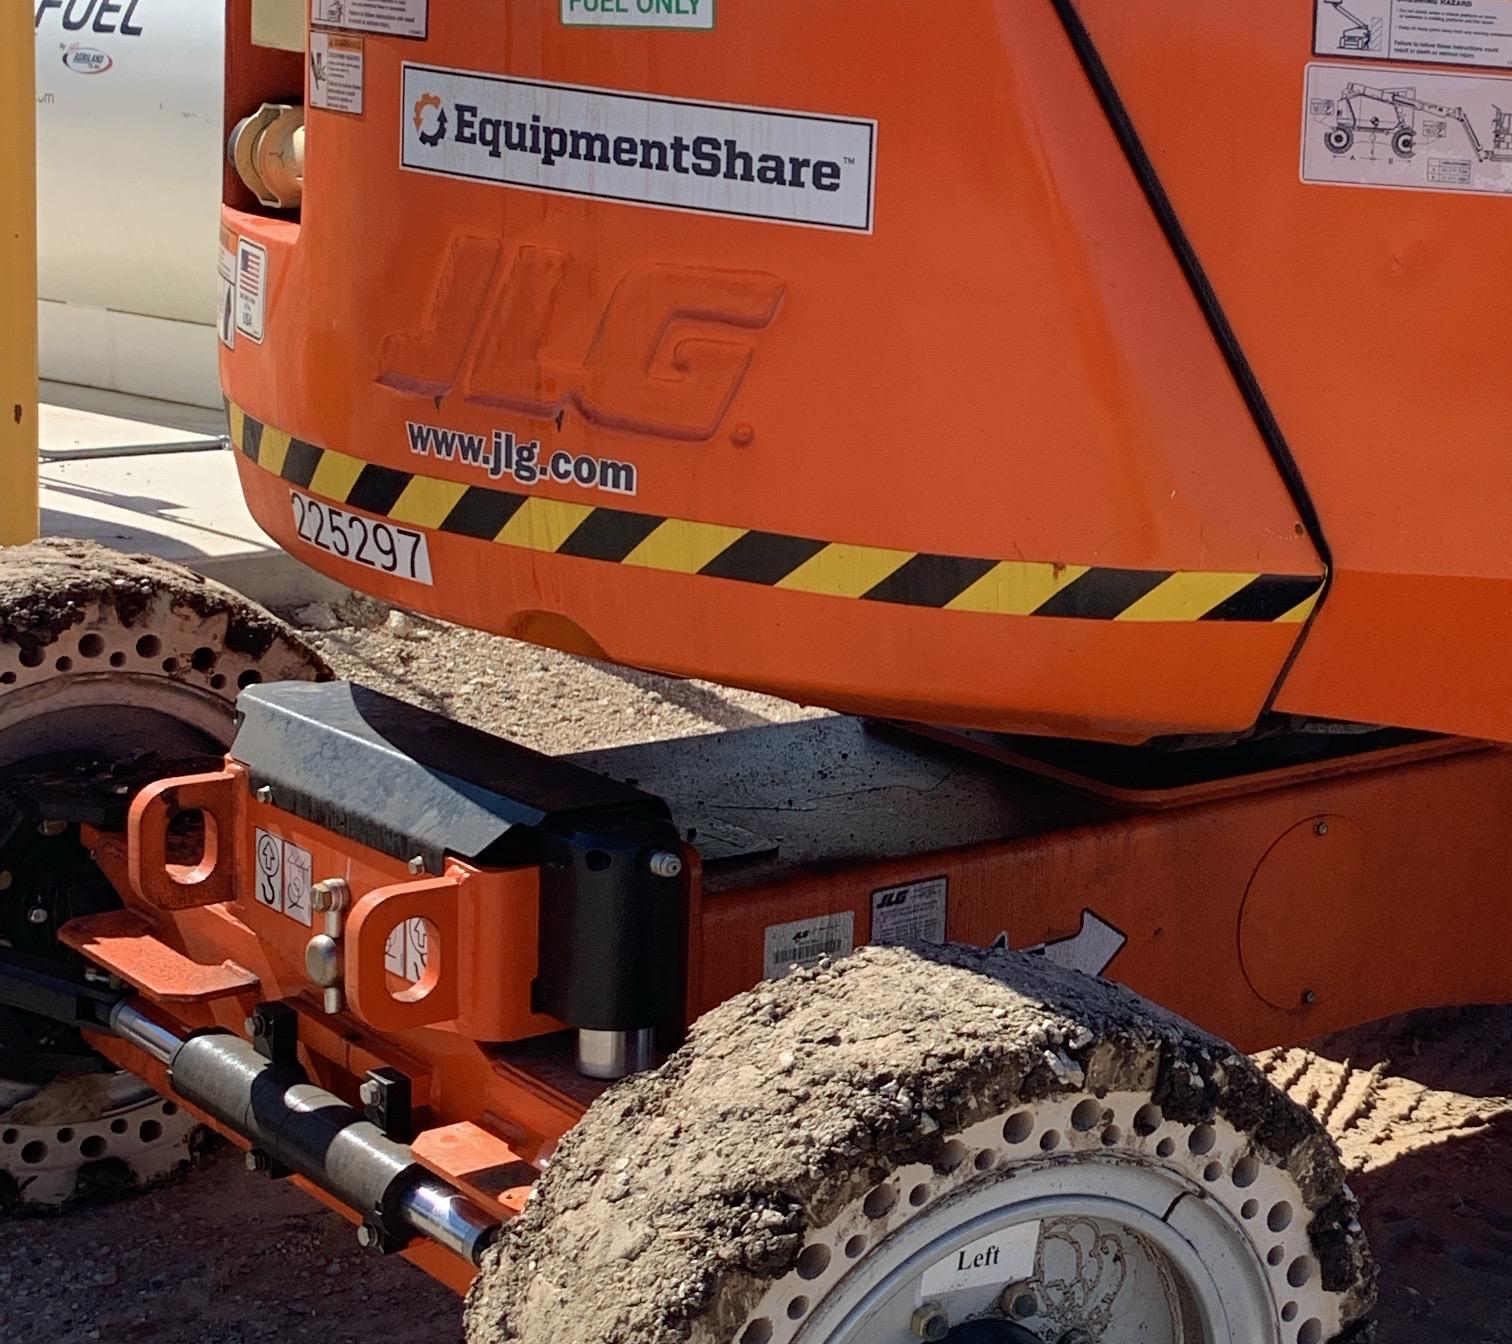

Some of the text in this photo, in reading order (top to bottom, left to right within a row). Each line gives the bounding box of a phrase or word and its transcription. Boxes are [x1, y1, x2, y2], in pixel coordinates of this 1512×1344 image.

[453, 103, 842, 193] EquipmentShare
[407, 421, 637, 496] www.jlg.com
[291, 491, 421, 579] 225297
[876, 889, 910, 909] JLG
[956, 1244, 1001, 1272] Left
